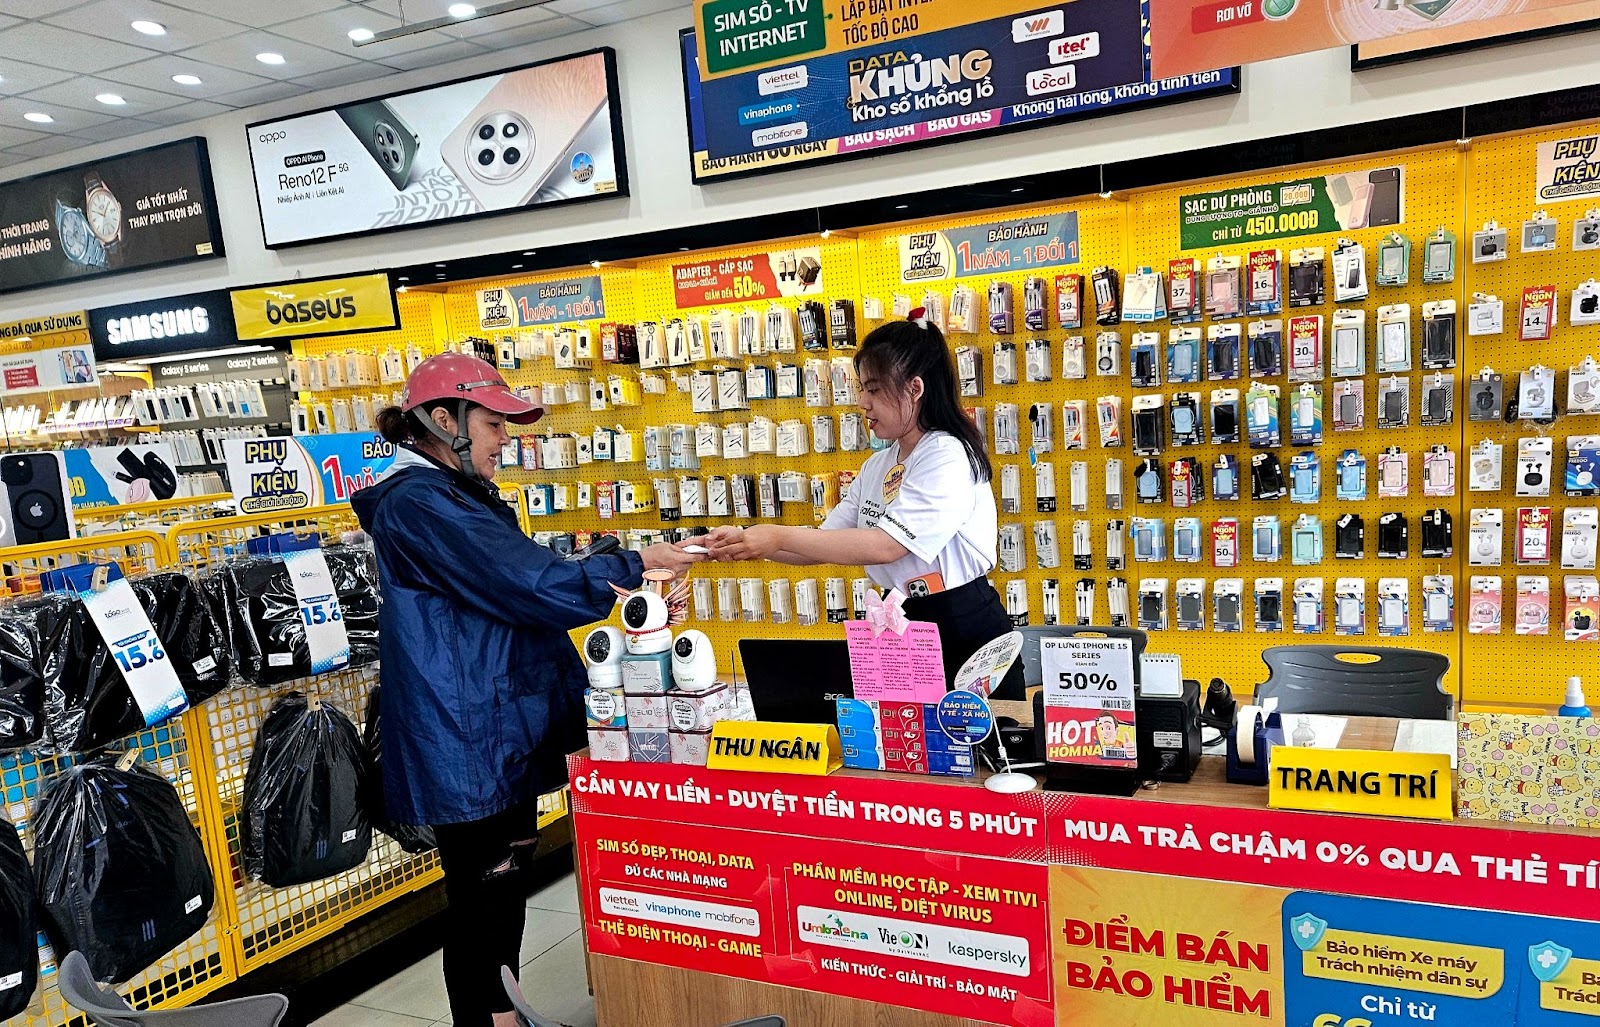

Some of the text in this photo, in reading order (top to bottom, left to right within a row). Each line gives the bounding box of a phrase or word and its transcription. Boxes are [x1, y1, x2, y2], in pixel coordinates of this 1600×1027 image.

[843, 13, 919, 45] TỐC ĐỘ CAO
[1216, 8, 1235, 24] RƠI
[719, 20, 808, 57] INTERNET
[849, 50, 908, 73] DATA
[764, 70, 800, 84] viettel
[849, 49, 993, 103] KHỦNG
[744, 103, 793, 120] vinaphone
[757, 126, 803, 143] mobifone
[1553, 137, 1598, 159] PHỤ
[278, 163, 349, 191] Reno12 F 5G
[1553, 160, 1600, 186] KIỆN
[136, 186, 188, 211] GIÁ TỐT NHẤT
[1185, 189, 1308, 216] SẠC DỰ PHÒNG 20.000
[128, 202, 203, 229] THAY PIN TRỌN ĐỜI
[1, 219, 50, 239] THỜI TRANG
[909, 233, 937, 250] PHỤ
[988, 222, 1049, 242] BẢO HÀNH
[1212, 226, 1229, 241] CHỈ
[1230, 224, 1242, 238] TỪ
[676, 260, 754, 280] ADAPTER CÁP SẠC
[911, 250, 941, 270] KIỆN
[484, 289, 502, 303] PHỤ
[539, 283, 581, 299] BẢO HÀNH
[265, 295, 357, 326] baseus
[486, 303, 507, 319] KIỆN
[11, 314, 82, 336] ĐÃ QUA SỬ DỤNG
[106, 306, 209, 345] SAMSUNG
[161, 362, 209, 376] Galaxy S series
[227, 359, 251, 369] Galaxy
[258, 355, 278, 366] series
[245, 439, 287, 465] PHỤ
[362, 434, 393, 459] BẢO
[251, 467, 297, 497] KIỆN
[322, 455, 382, 501] 1 NĂ
[1071, 652, 1101, 660] SERIES
[1059, 672, 1118, 692] 50%
[901, 709, 915, 718] 4G
[1047, 720, 1096, 746] HOT
[714, 736, 821, 761] THU NGÂN
[1049, 744, 1103, 758] HÔM NA
[1277, 767, 1439, 799] TRANG TRÍ
[575, 769, 1038, 837] CẦN VAY LIỀN DUYỆT TIỀN TRONG 5 PHÚT
[596, 835, 754, 870] SIM SỐ ĐẸP, THOẠI, DATA
[1064, 818, 1600, 889] MUA TRẢ CHẬM 0% QUA THẺ TÍ
[624, 862, 728, 889] ĐỦ CÁC NHÀ MẠNG
[792, 862, 1039, 908] PHẦN MỀM HỌC TẬP XEM TIVI
[604, 894, 639, 907] viettel
[645, 901, 701, 919] vinaphone
[705, 912, 756, 927] mobifone
[834, 888, 993, 924] ONLINE, DIỆT VIRUS
[598, 919, 763, 958] THẺ ĐIỆN THOẠI GAME
[1062, 913, 1270, 973] ĐIỂM BÁN
[948, 941, 1027, 968] kaspersky
[1326, 940, 1478, 973] Bảo hiểm Xe máy
[821, 956, 1018, 1002] KIẾN THỨC GIẢI TRÍ BẢO MẬT
[1317, 955, 1489, 991] Trách nhiệm dân sự
[1066, 955, 1271, 1018] BẢO HIỂM
[1360, 994, 1437, 1021] Chỉ từ
